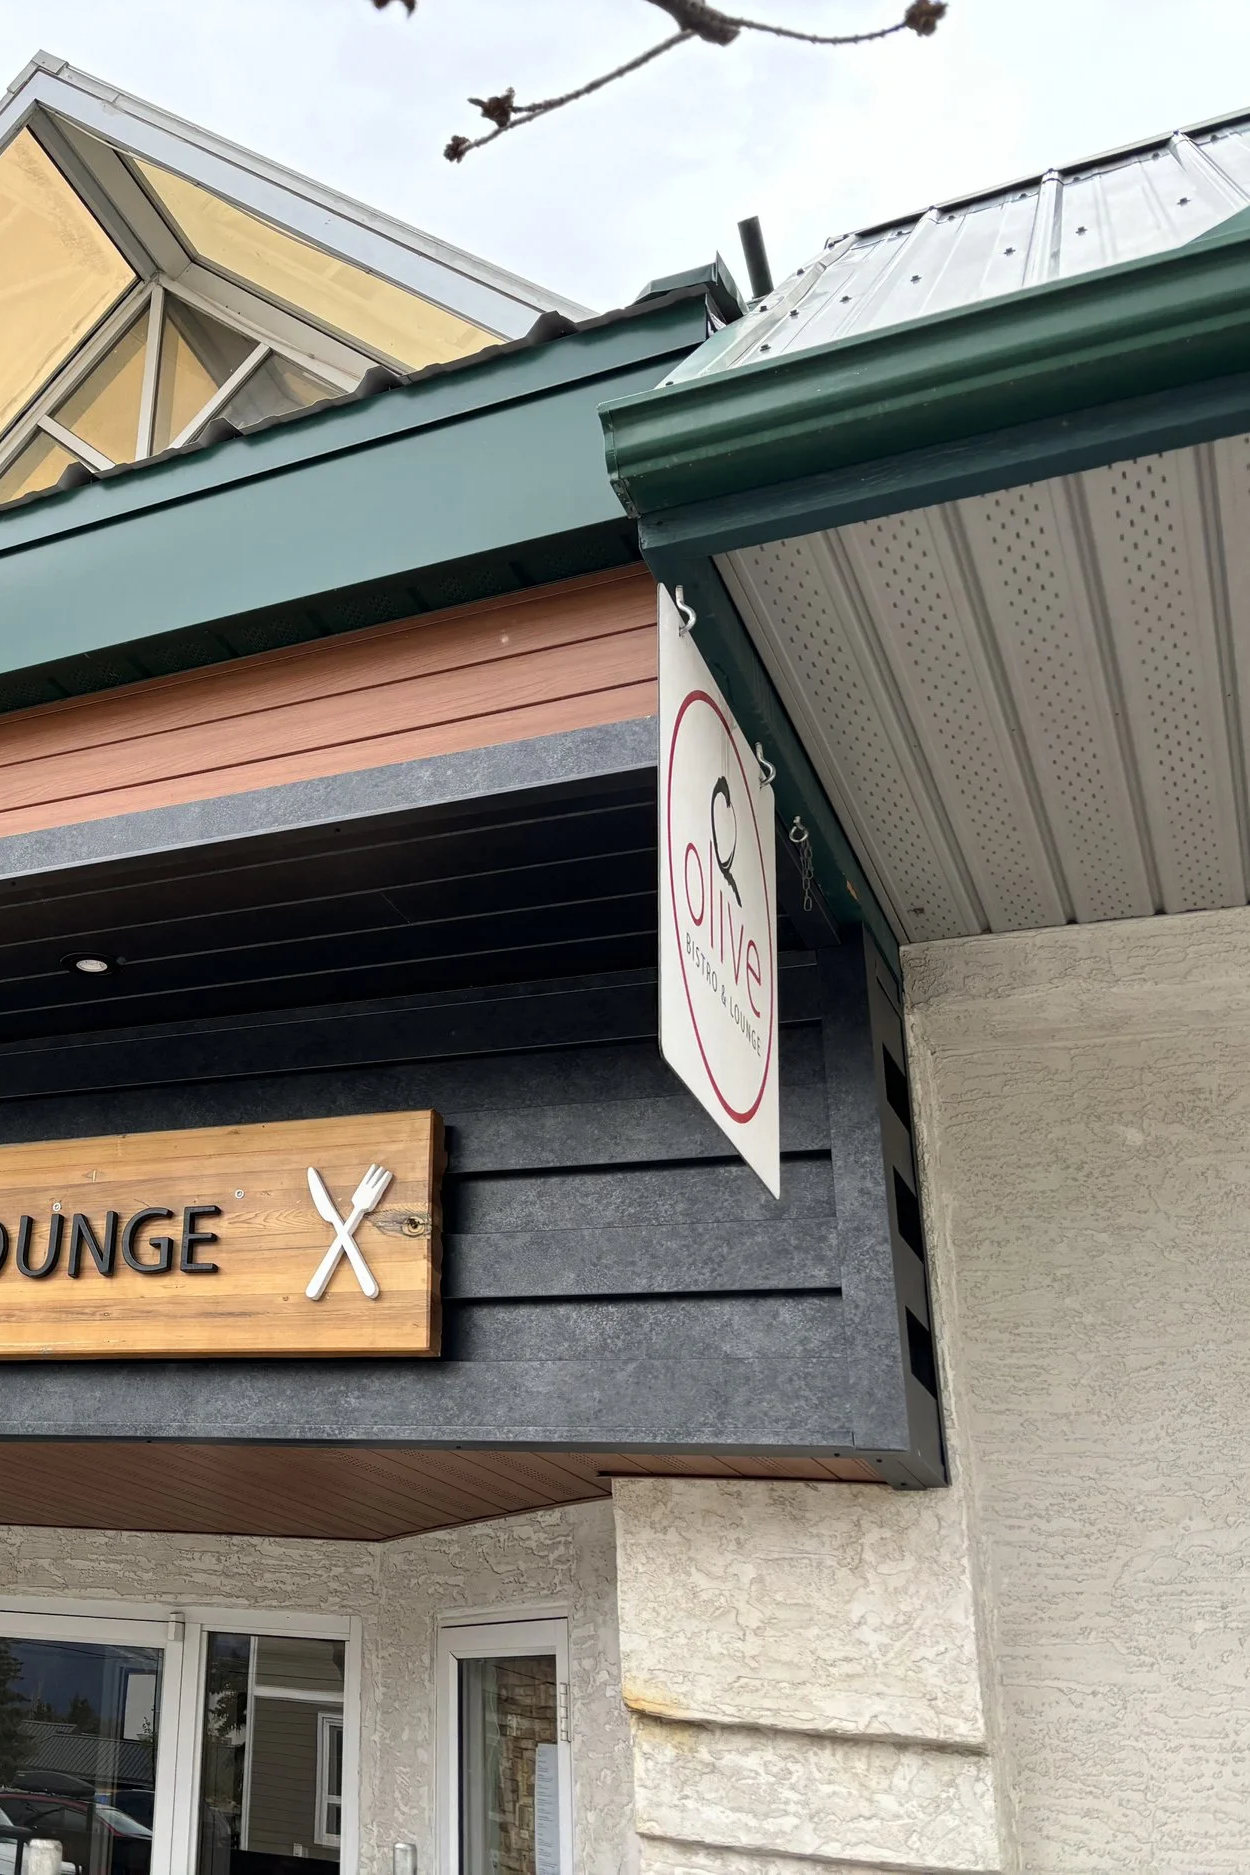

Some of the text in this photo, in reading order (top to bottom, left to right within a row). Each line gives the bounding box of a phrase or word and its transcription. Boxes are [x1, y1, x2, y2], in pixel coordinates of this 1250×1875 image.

[684, 841, 761, 1018] olive
[686, 931, 762, 1057] BISTRO & LOUNGE
